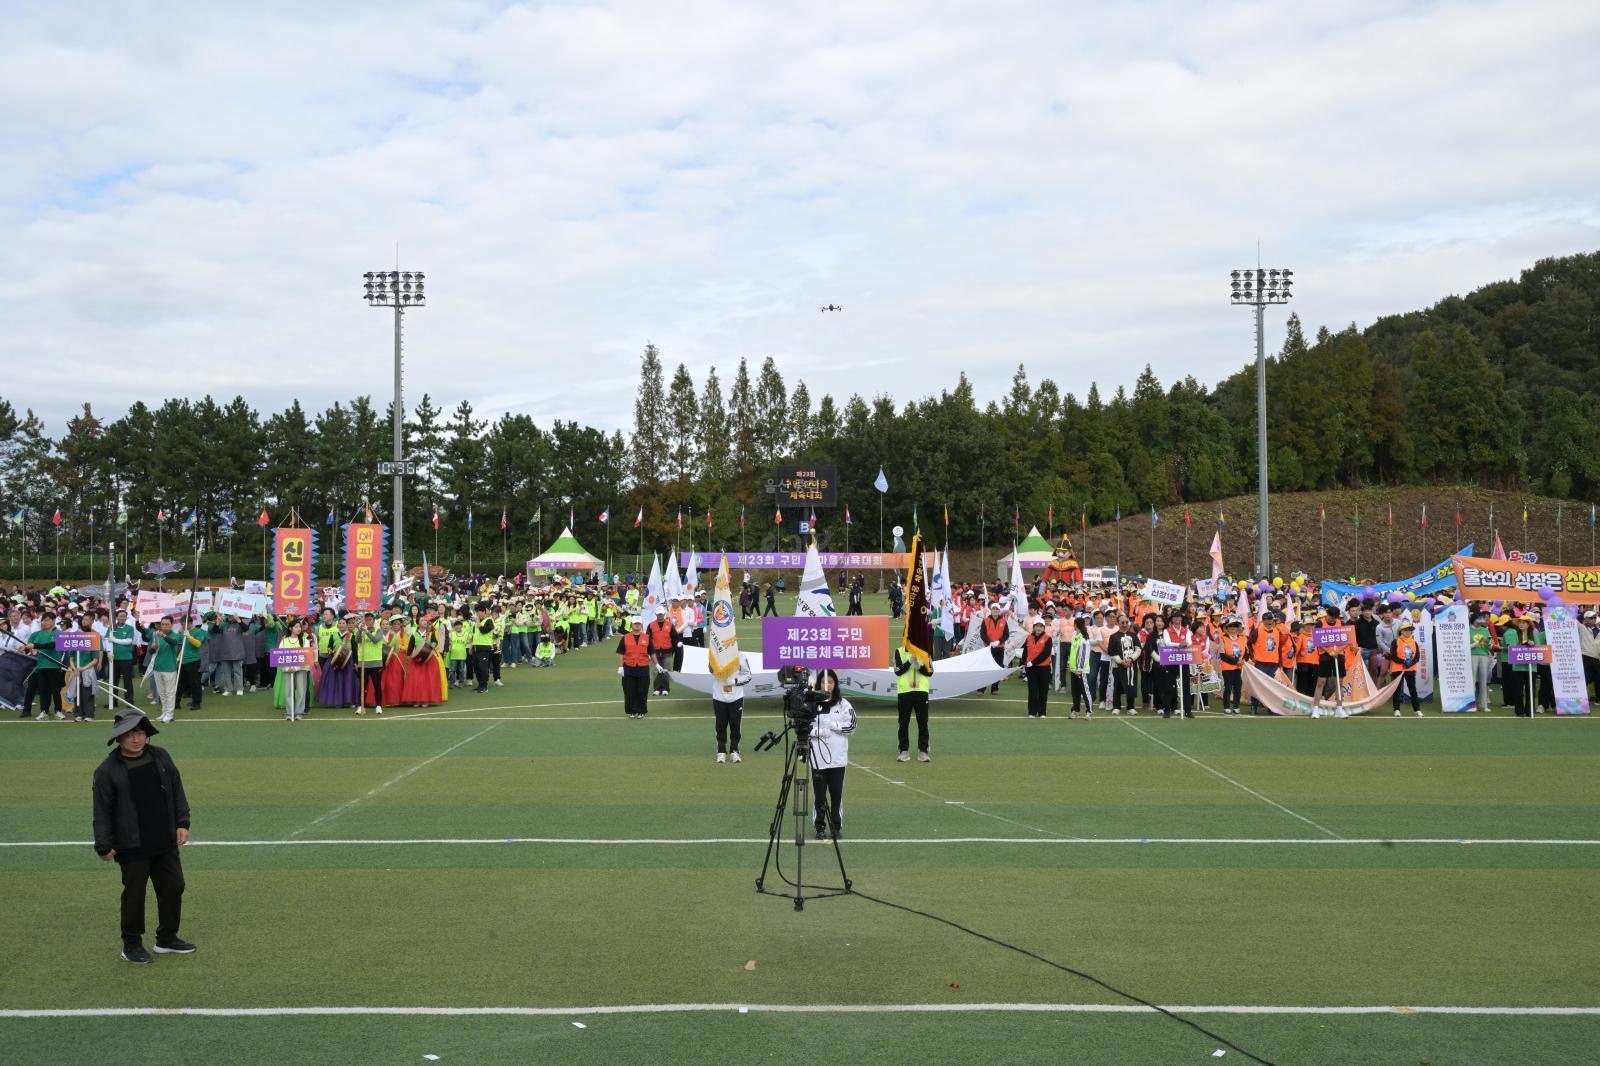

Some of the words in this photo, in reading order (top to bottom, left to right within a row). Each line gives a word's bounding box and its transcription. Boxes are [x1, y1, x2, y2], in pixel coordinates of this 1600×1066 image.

[802, 522, 811, 533] B
[737, 554, 775, 566] 제23회
[779, 554, 801, 566] 구민
[818, 554, 883, 566] 마음체육대회
[1463, 567, 1514, 588] 울산의
[1514, 572, 1563, 593] 심장은
[786, 627, 832, 642] 제23회
[837, 627, 863, 642] 구민
[1320, 633, 1348, 643] 신정3동
[63, 639, 92, 648] 신정4동
[778, 645, 871, 660] 한마음체육대회
[1168, 653, 1193, 662] 신정1동
[1516, 652, 1544, 661] 신정5동
[278, 654, 305, 664] 신정2동
